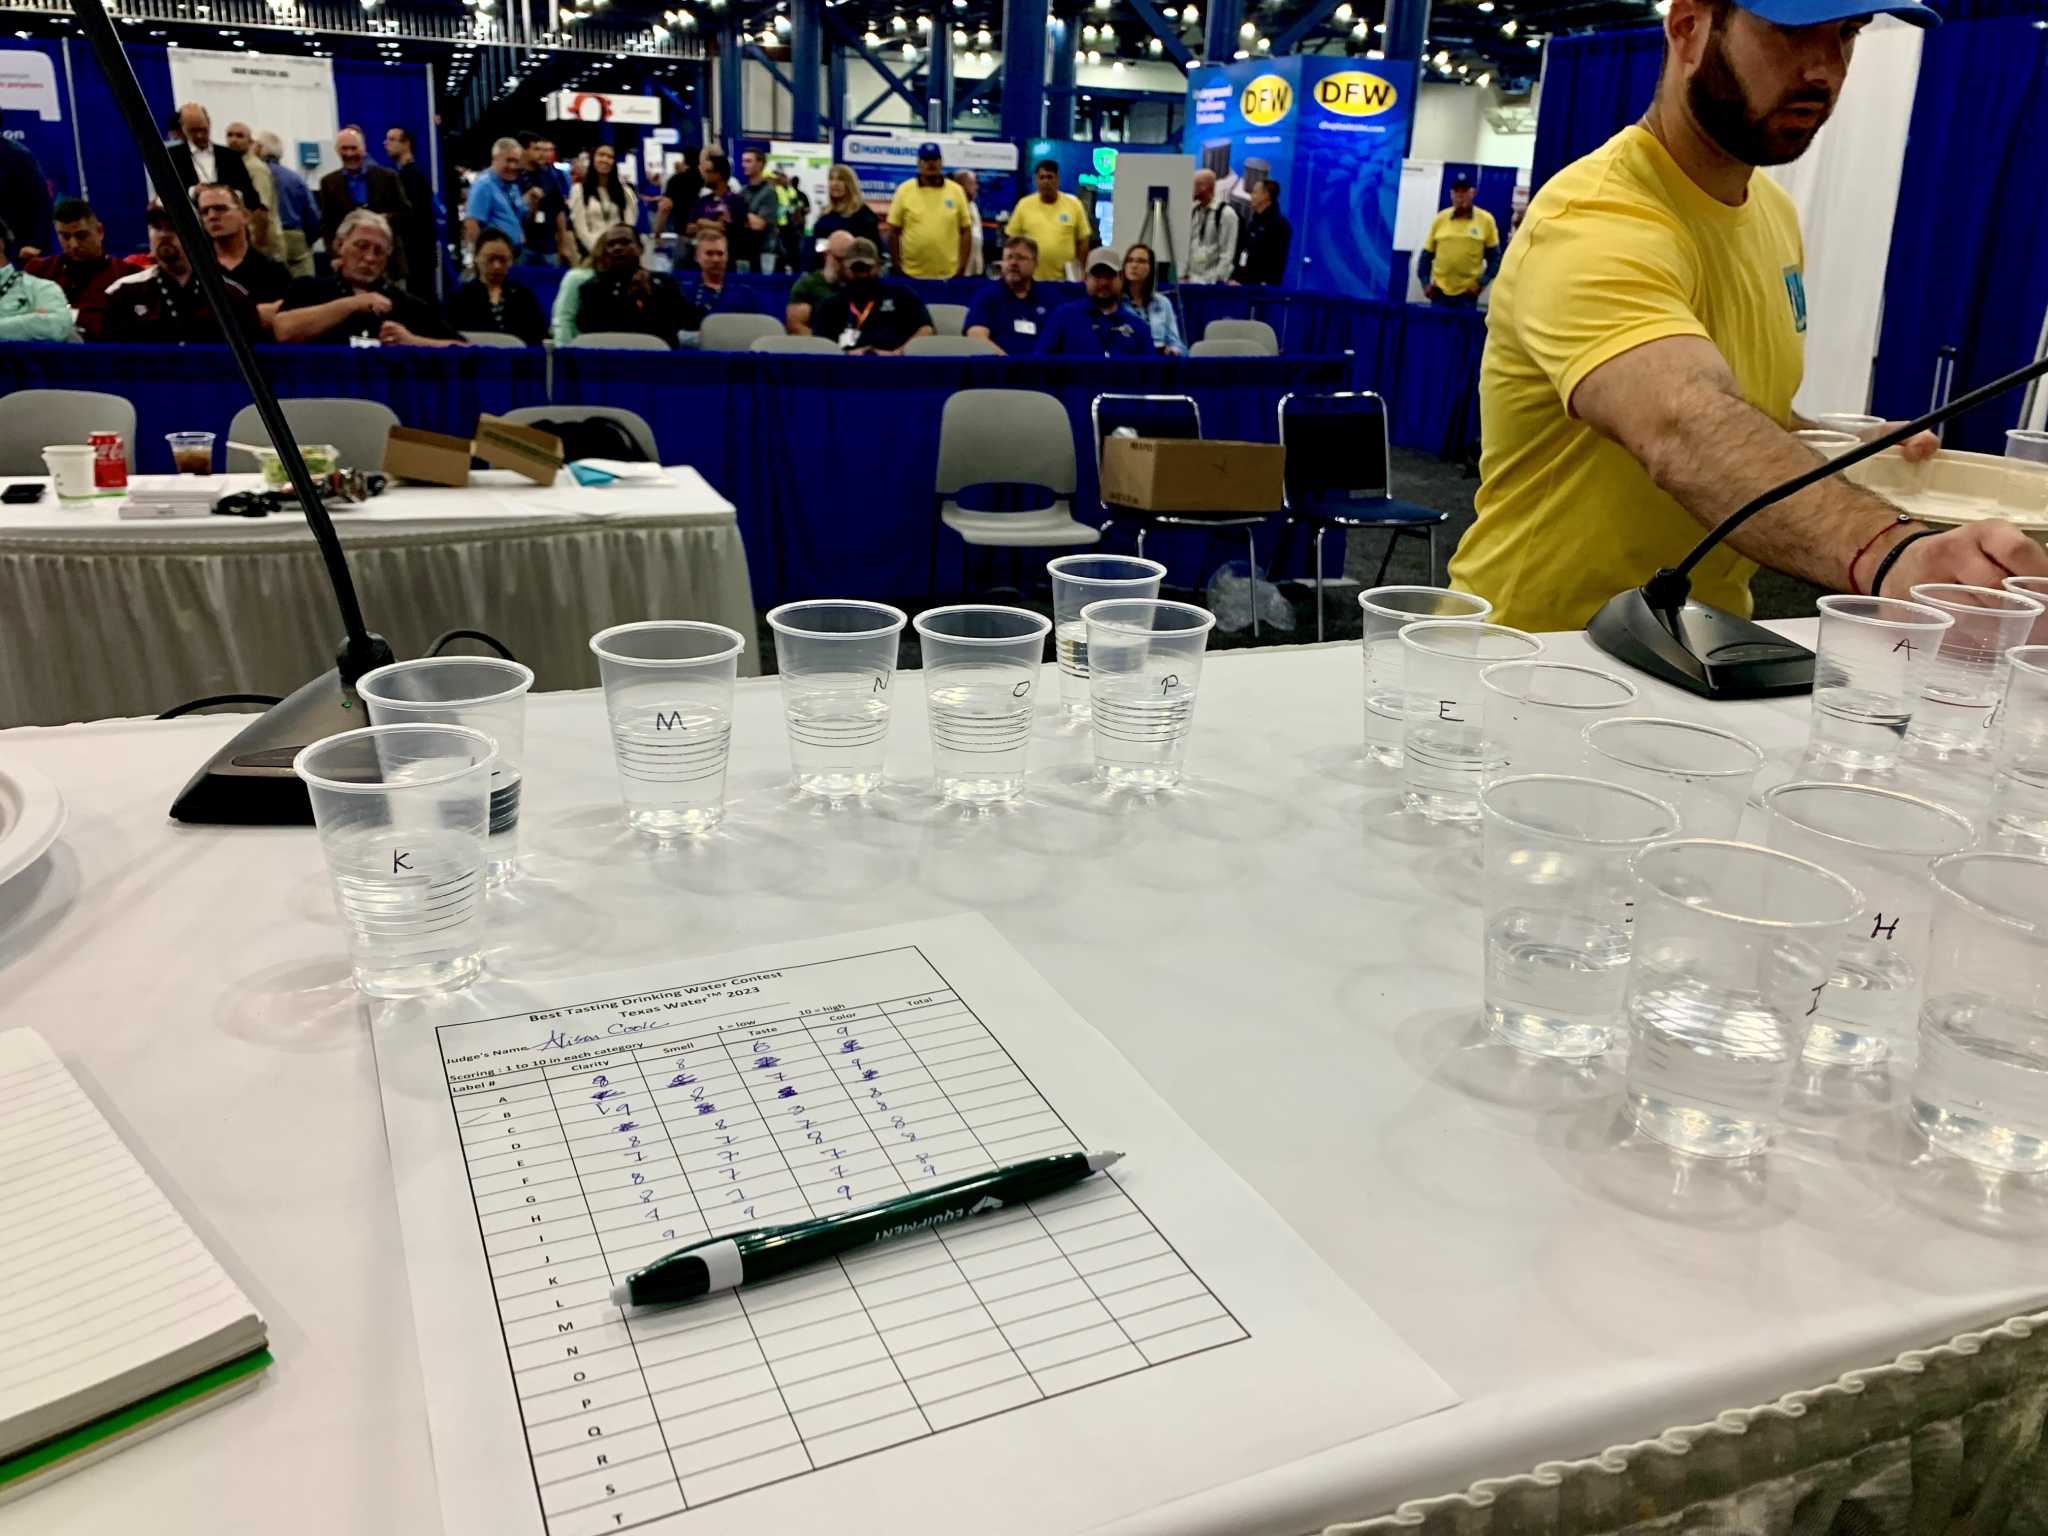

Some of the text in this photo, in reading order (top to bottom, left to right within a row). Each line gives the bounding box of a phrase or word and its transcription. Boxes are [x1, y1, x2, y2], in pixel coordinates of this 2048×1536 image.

[1321, 81, 1391, 106] DFW
[1244, 86, 1290, 114] DFW
[1892, 638, 1918, 661] A
[873, 670, 890, 692] N
[1161, 674, 1178, 695] P
[1438, 700, 1465, 722] E
[655, 710, 687, 731] M
[392, 847, 414, 874] K
[1870, 912, 1900, 940] H
[529, 971, 783, 1023] Best Tasting Drinking Water Contest
[619, 1005, 661, 1019] Texas
[727, 985, 761, 998] 2023
[907, 997, 933, 1007] Total
[800, 1008, 812, 1016] 10
[822, 1003, 846, 1013] high
[829, 1012, 857, 1022] Color
[735, 1019, 756, 1028] low
[749, 1027, 778, 1036] Taste
[663, 1042, 695, 1054] Smell
[446, 1045, 529, 1066] Judge's Name
[450, 1068, 495, 1082] Scoring
[516, 1061, 529, 1070] to
[531, 1058, 546, 1067] 10
[549, 1056, 561, 1064] in
[564, 1051, 591, 1062] each
[594, 1041, 644, 1057] category
[571, 1059, 609, 1072] Clarity
[452, 1082, 480, 1093] Label
[511, 1142, 521, 1150] D
[523, 1177, 530, 1185] F
[837, 1185, 852, 1200] 9
[526, 1195, 536, 1203] G
[531, 1215, 541, 1223] H
[875, 1207, 963, 1241] EQUIPMENT
[548, 1276, 558, 1286] K
[556, 1300, 564, 1308] L
[557, 1321, 574, 1333] M
[566, 1346, 579, 1356] N
[573, 1371, 586, 1382] O
[582, 1398, 591, 1409] P
[588, 1426, 602, 1438] Q
[597, 1454, 608, 1465] R
[605, 1484, 615, 1496] S
[612, 1513, 623, 1525] T
